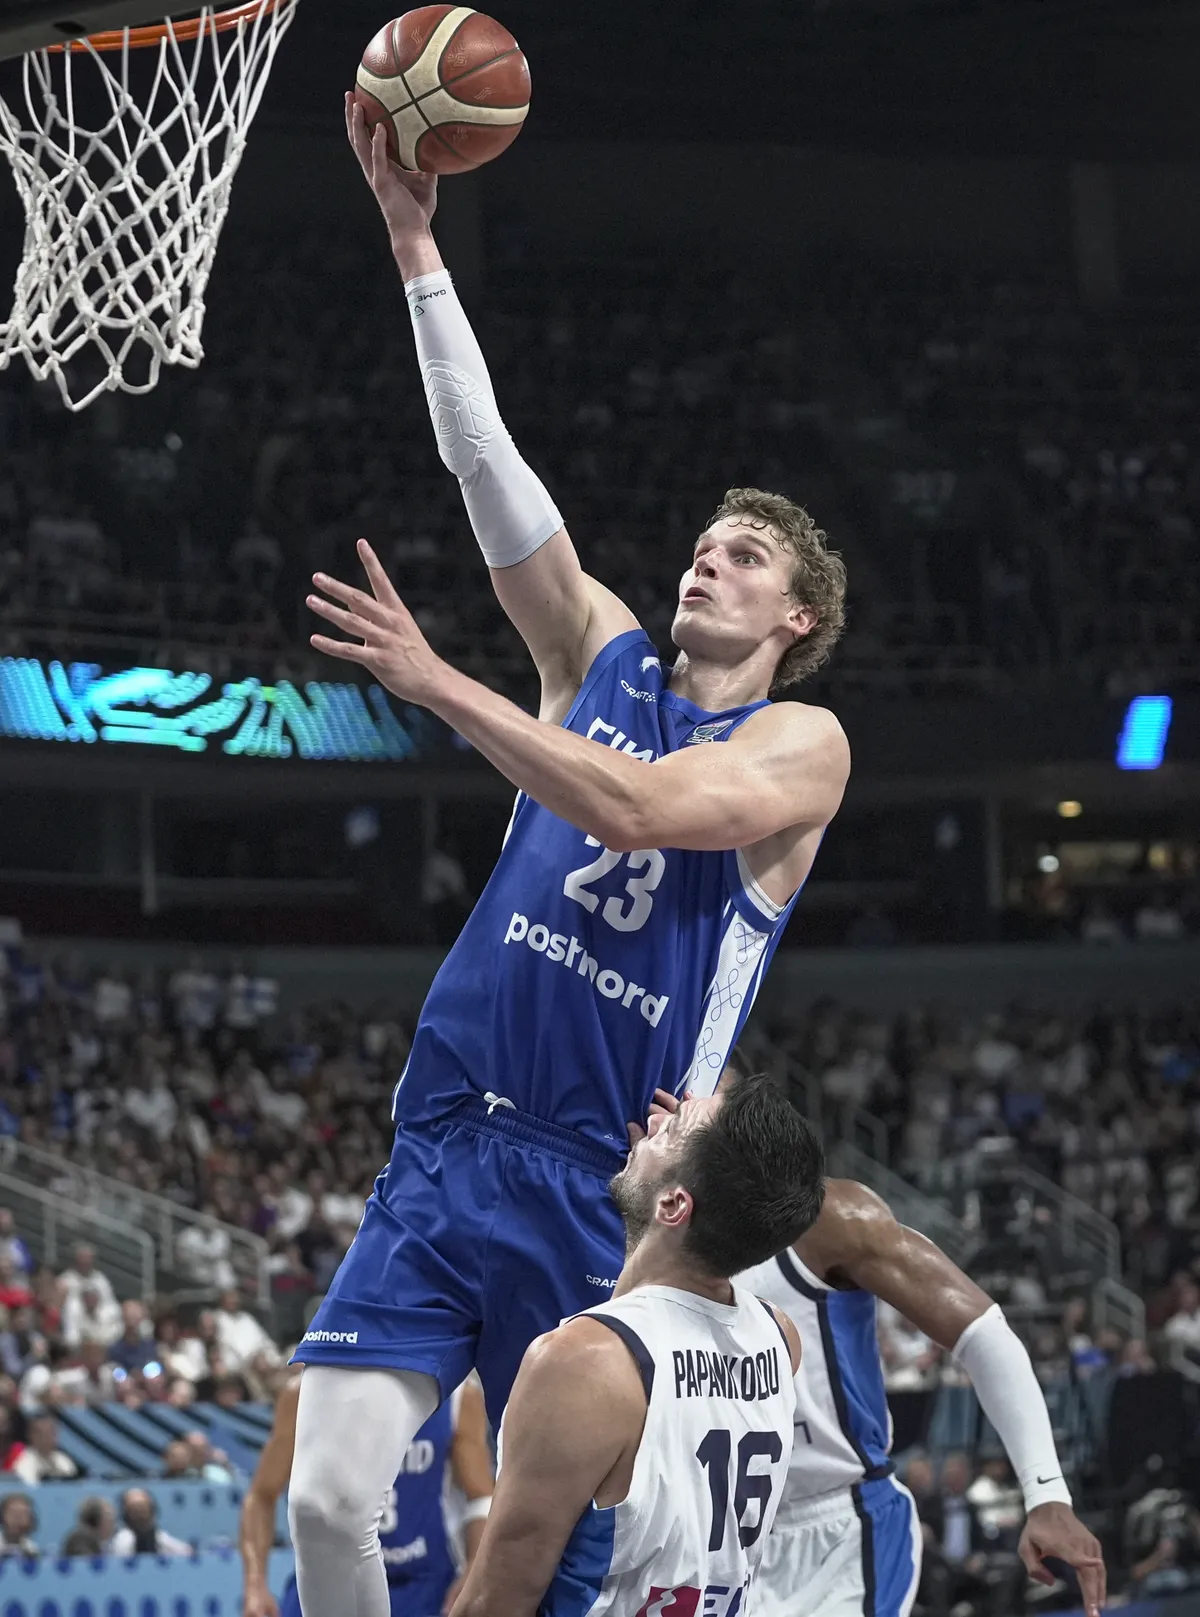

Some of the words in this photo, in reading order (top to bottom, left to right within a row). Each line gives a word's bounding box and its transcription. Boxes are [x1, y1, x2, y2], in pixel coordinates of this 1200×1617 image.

[417, 288, 447, 302] GAME
[563, 833, 666, 933] 23
[503, 912, 669, 1029] postnord
[586, 1274, 618, 1289] CRAF
[300, 1329, 359, 1344] postnord
[696, 1428, 783, 1552] 16
